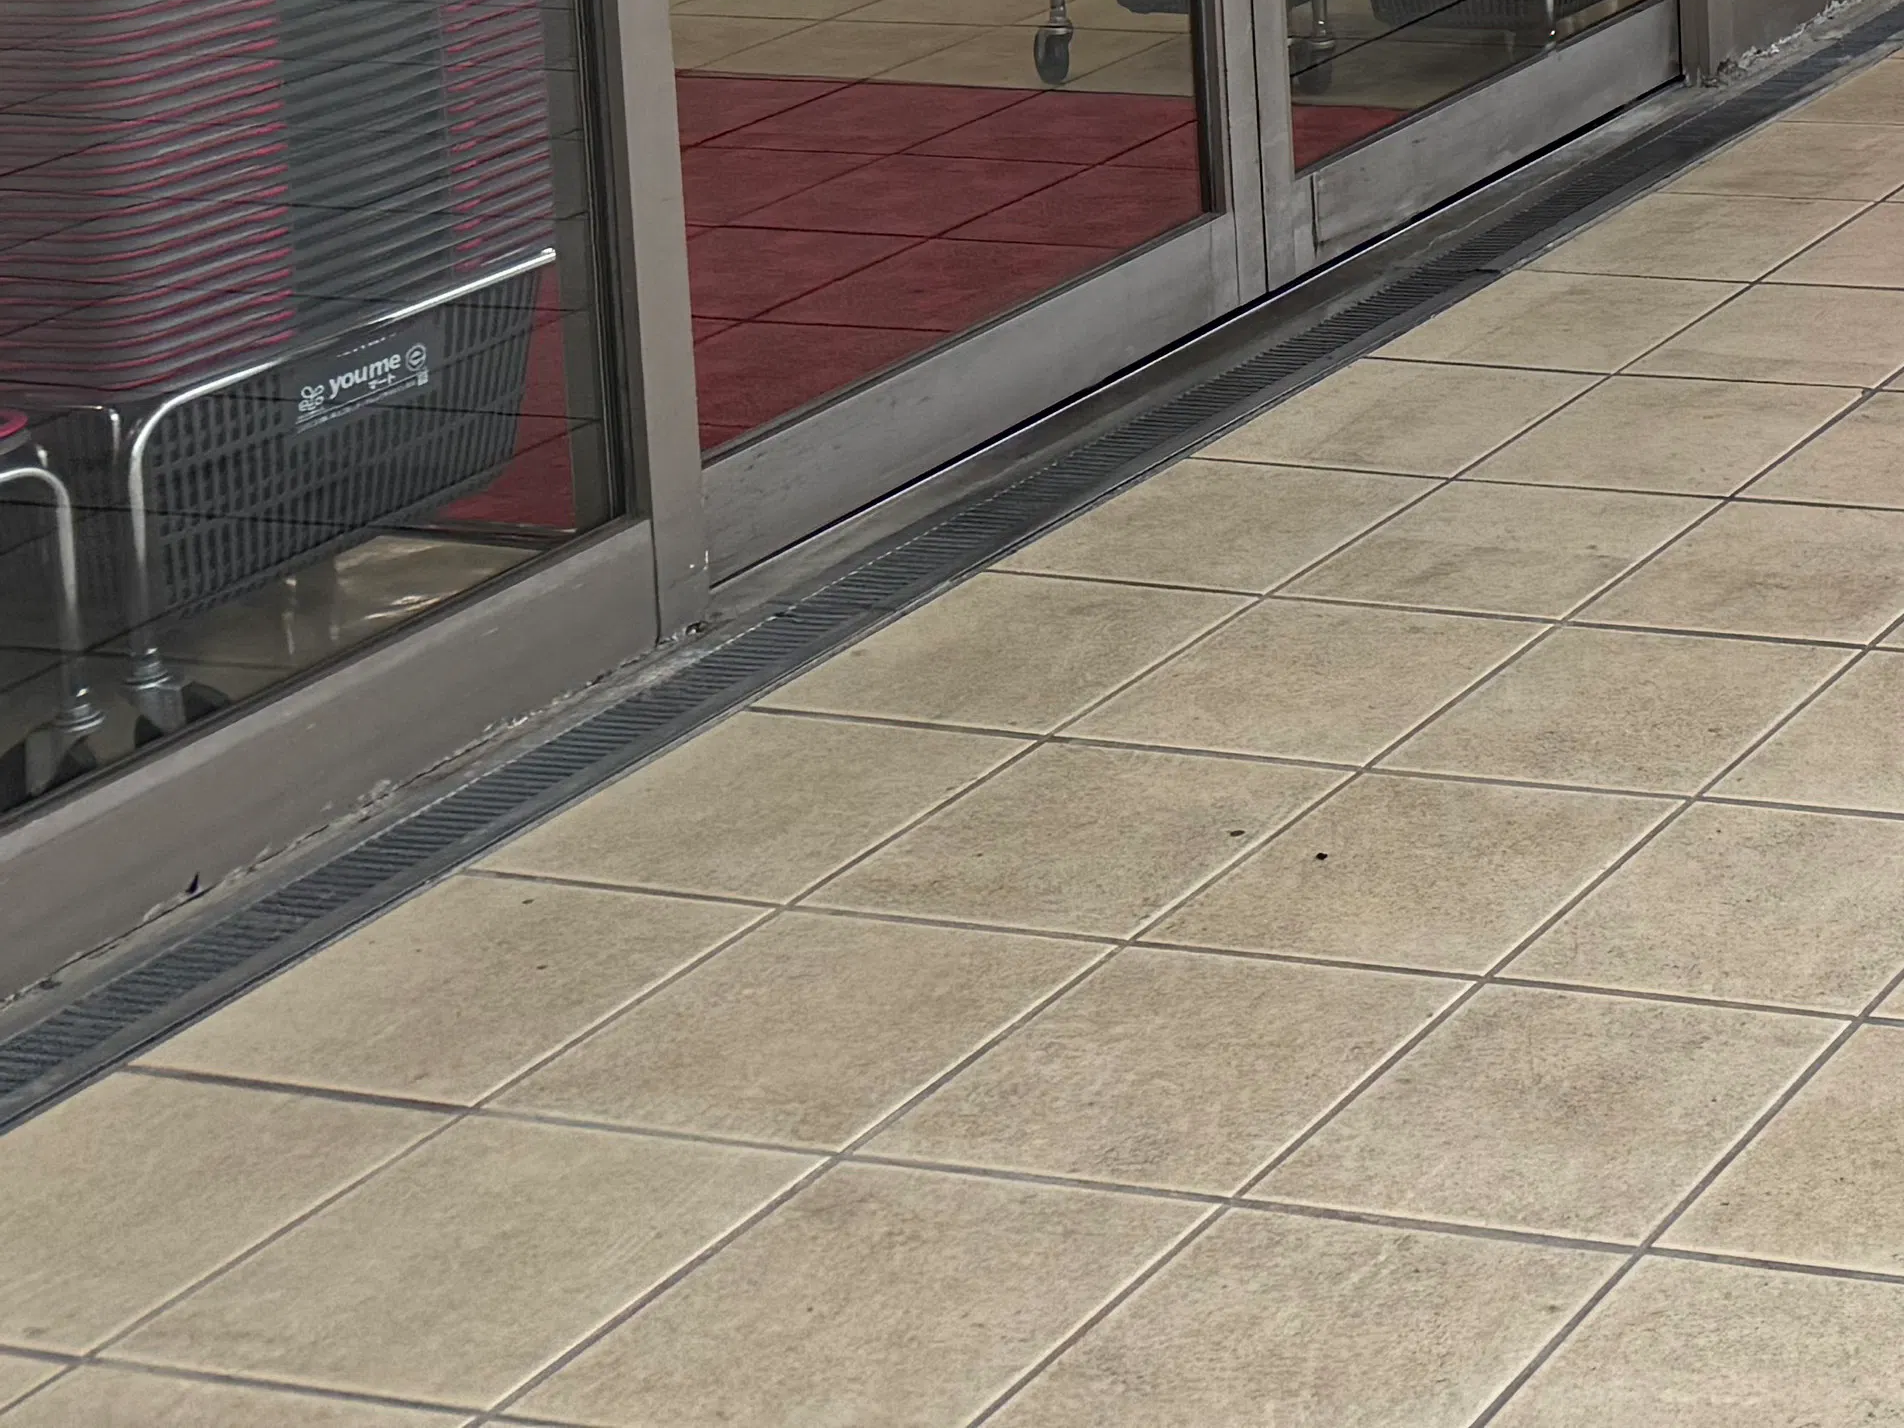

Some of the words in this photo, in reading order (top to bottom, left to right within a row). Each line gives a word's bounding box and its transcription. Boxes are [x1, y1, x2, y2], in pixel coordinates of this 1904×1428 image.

[329, 354, 401, 400] youme
[367, 373, 397, 390] マート
